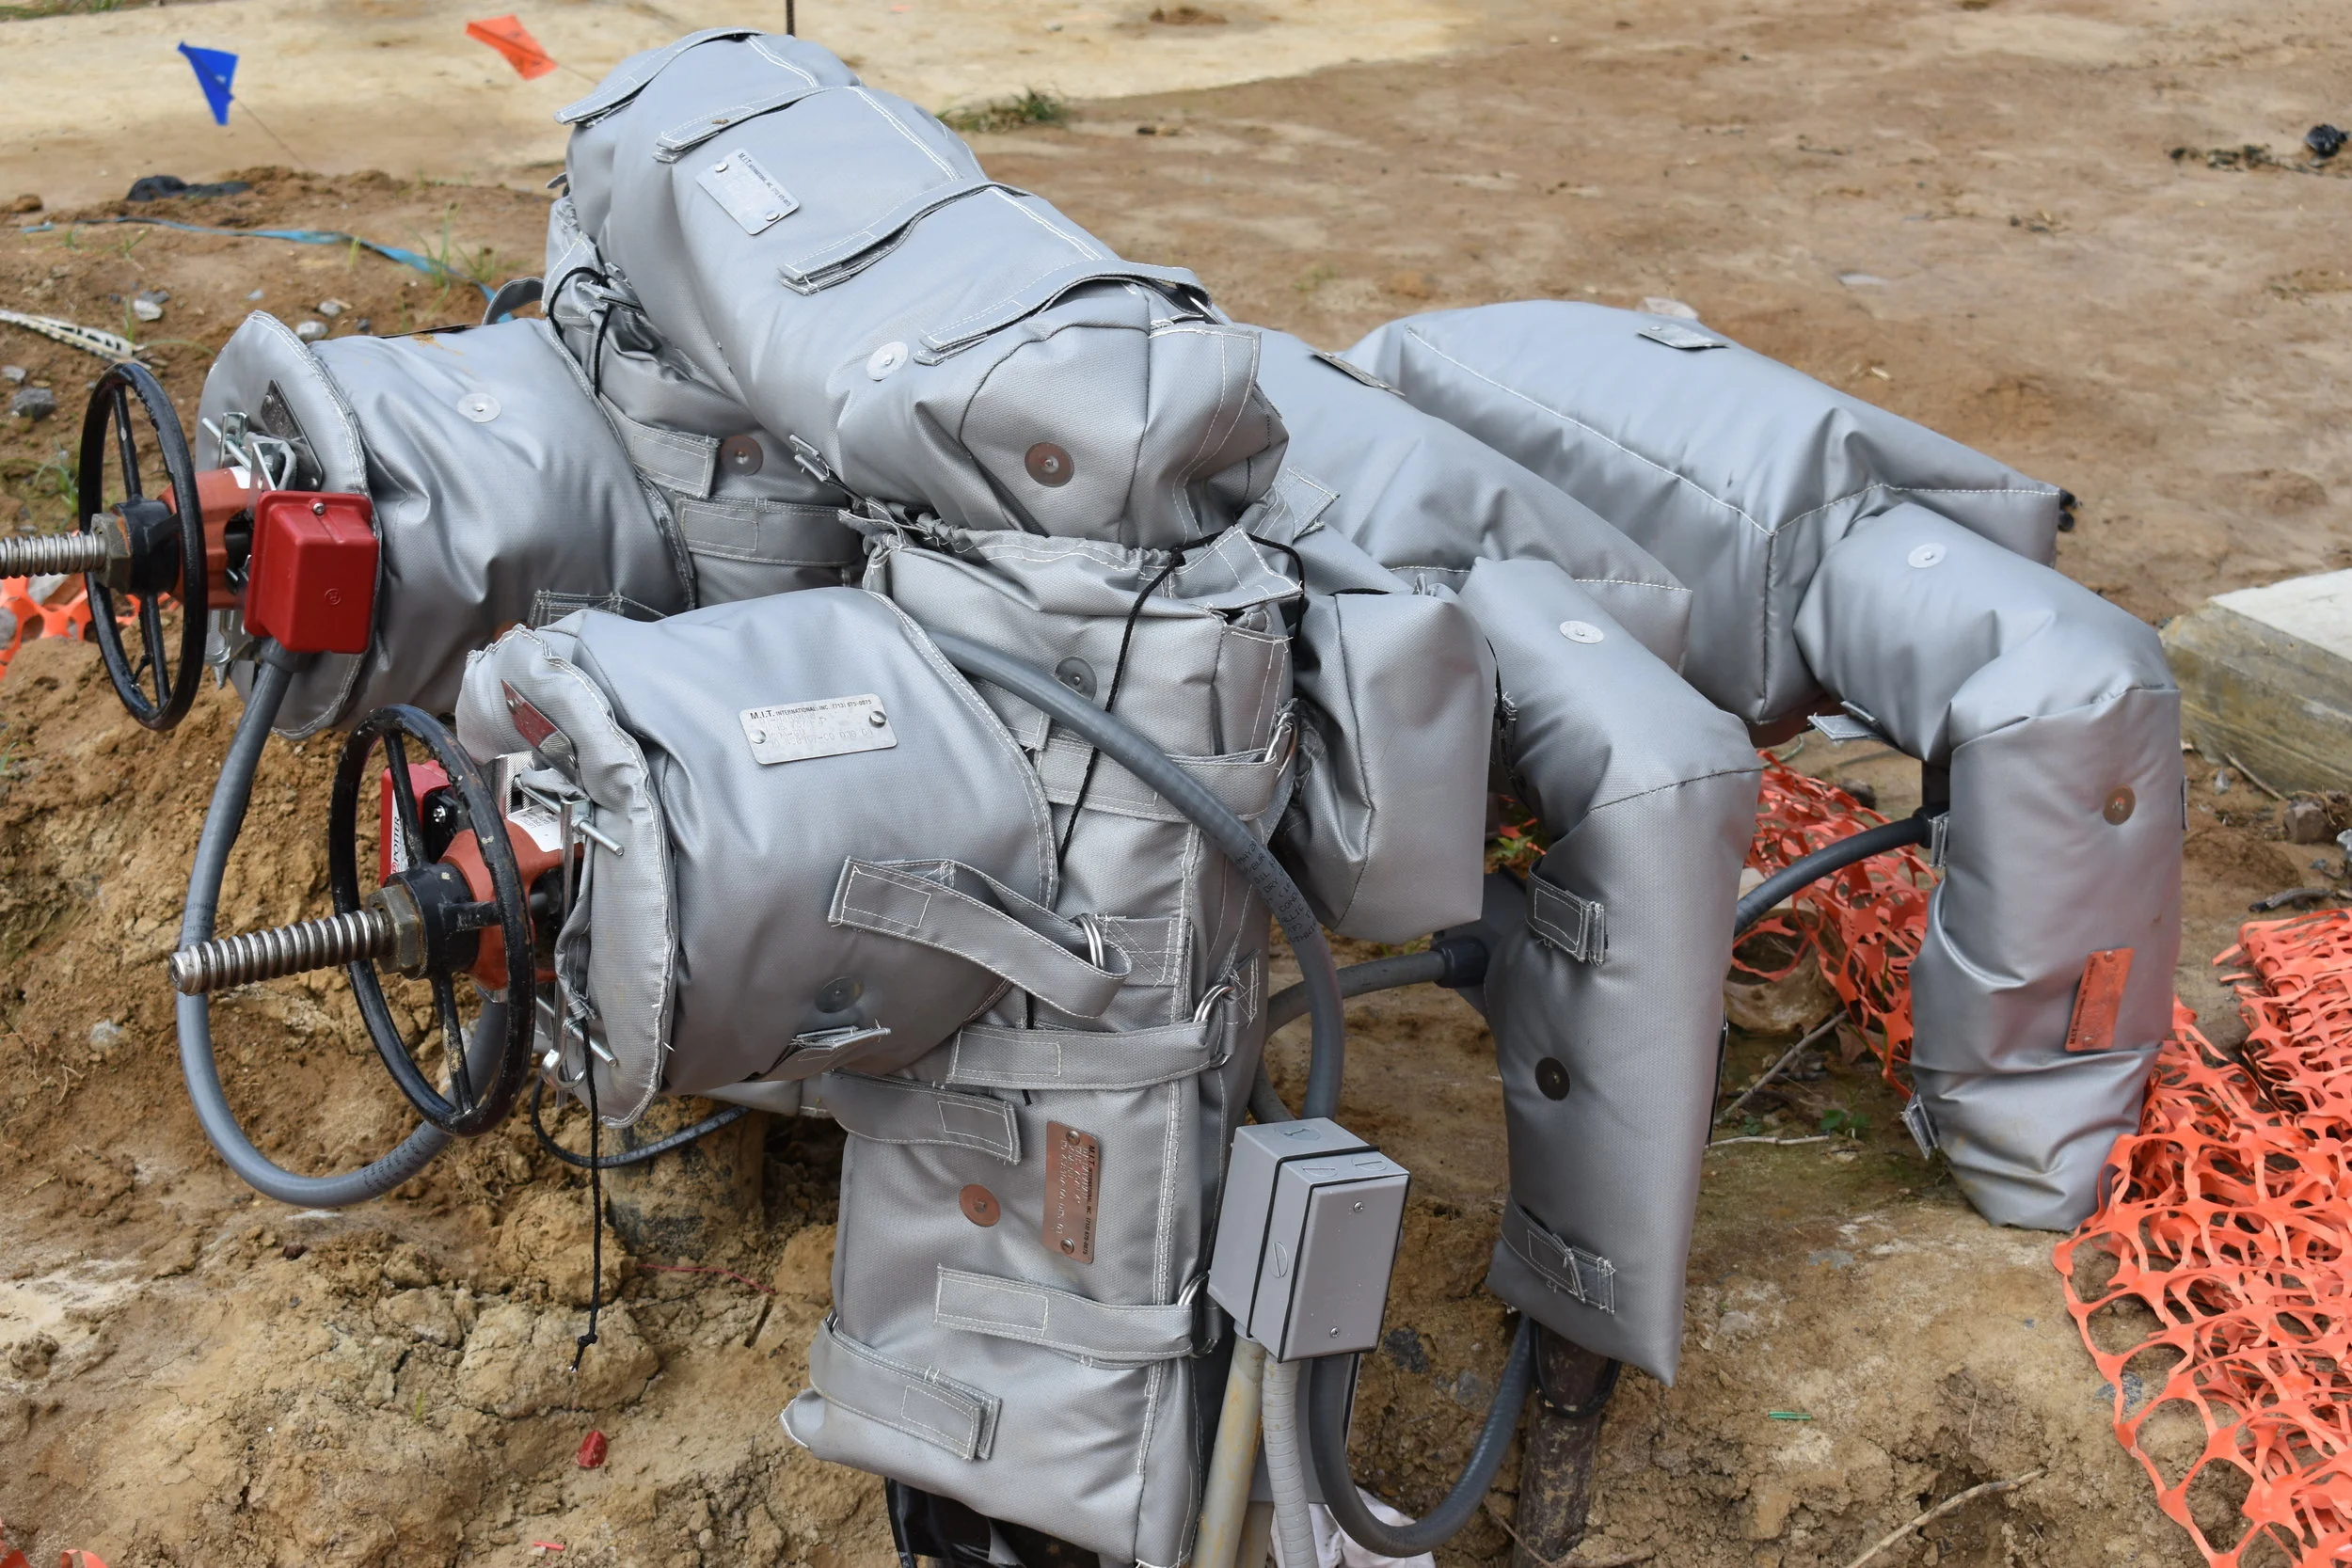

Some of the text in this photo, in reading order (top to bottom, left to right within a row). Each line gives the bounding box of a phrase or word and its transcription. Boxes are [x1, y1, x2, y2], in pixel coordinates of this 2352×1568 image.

[750, 709, 775, 720] M.I.T.
[1254, 872, 1271, 884] OIL
[1263, 878, 1279, 894] DRY
